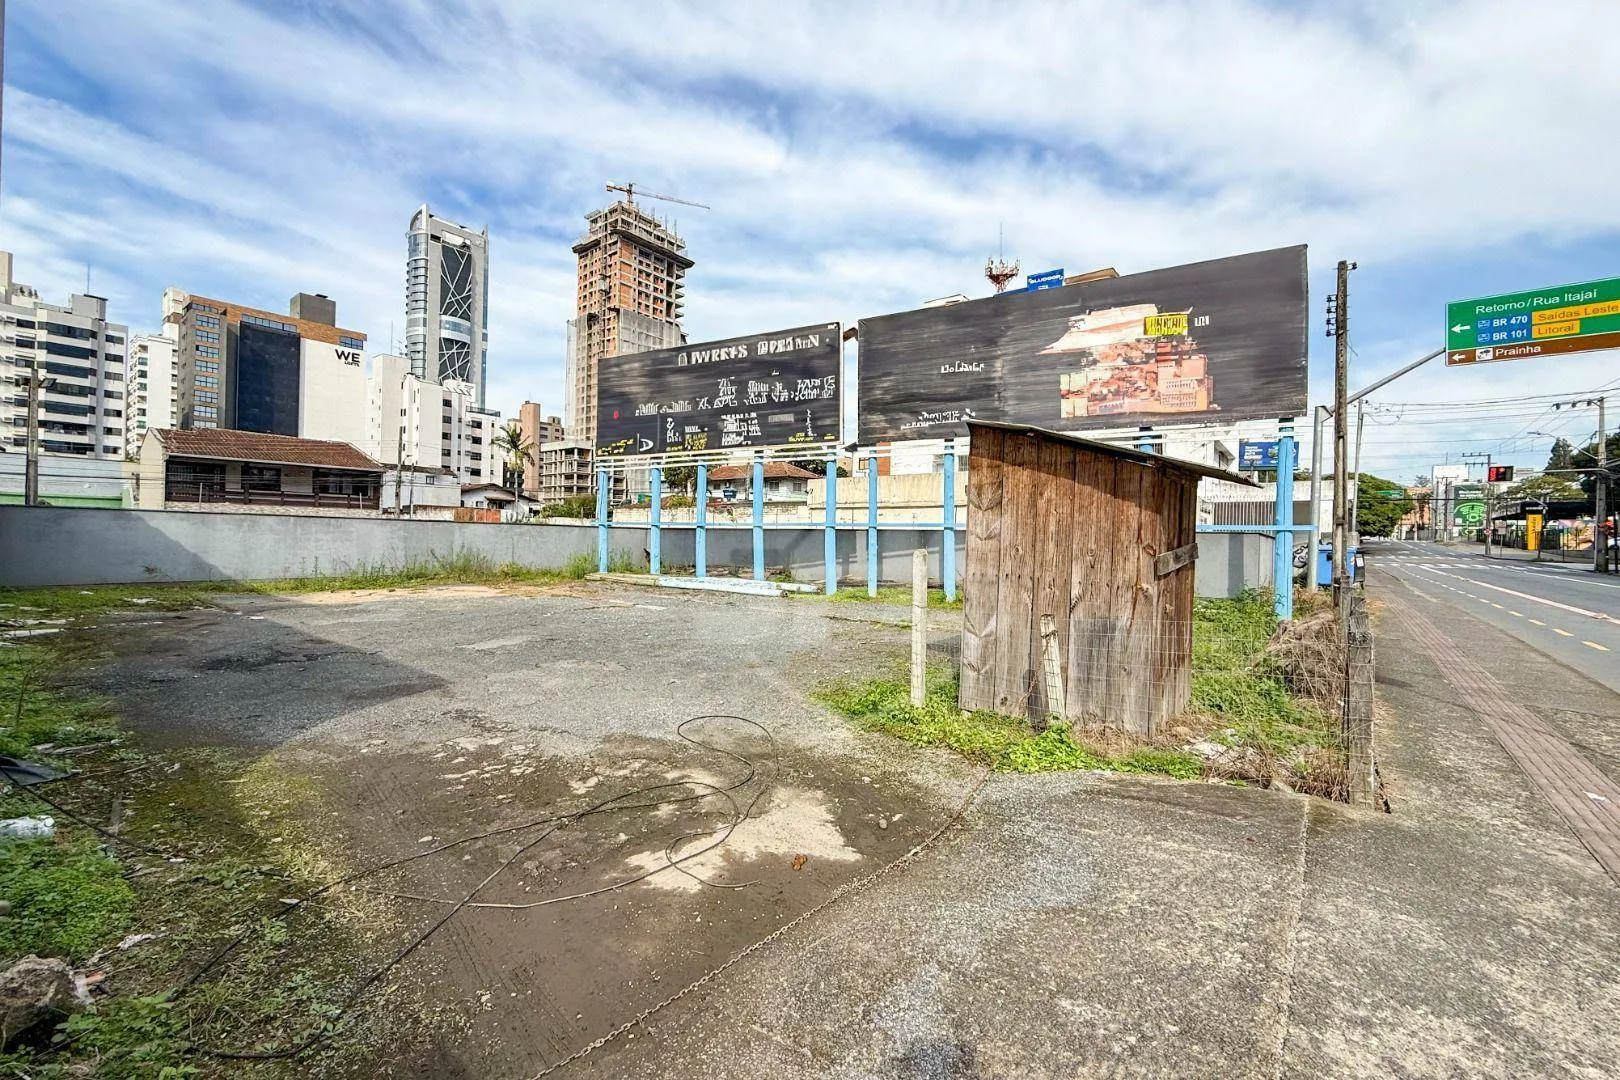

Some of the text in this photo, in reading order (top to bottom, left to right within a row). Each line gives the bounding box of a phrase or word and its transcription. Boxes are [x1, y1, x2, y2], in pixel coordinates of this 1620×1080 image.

[1564, 289, 1597, 302] Itajaí
[1538, 304, 1619, 321] Saídas Leste
[1492, 315, 1528, 327] BR 470
[1492, 329, 1527, 341] BR 101
[1538, 324, 1574, 334] Litoral
[335, 349, 360, 363] WE
[1495, 346, 1541, 356] Prainha
